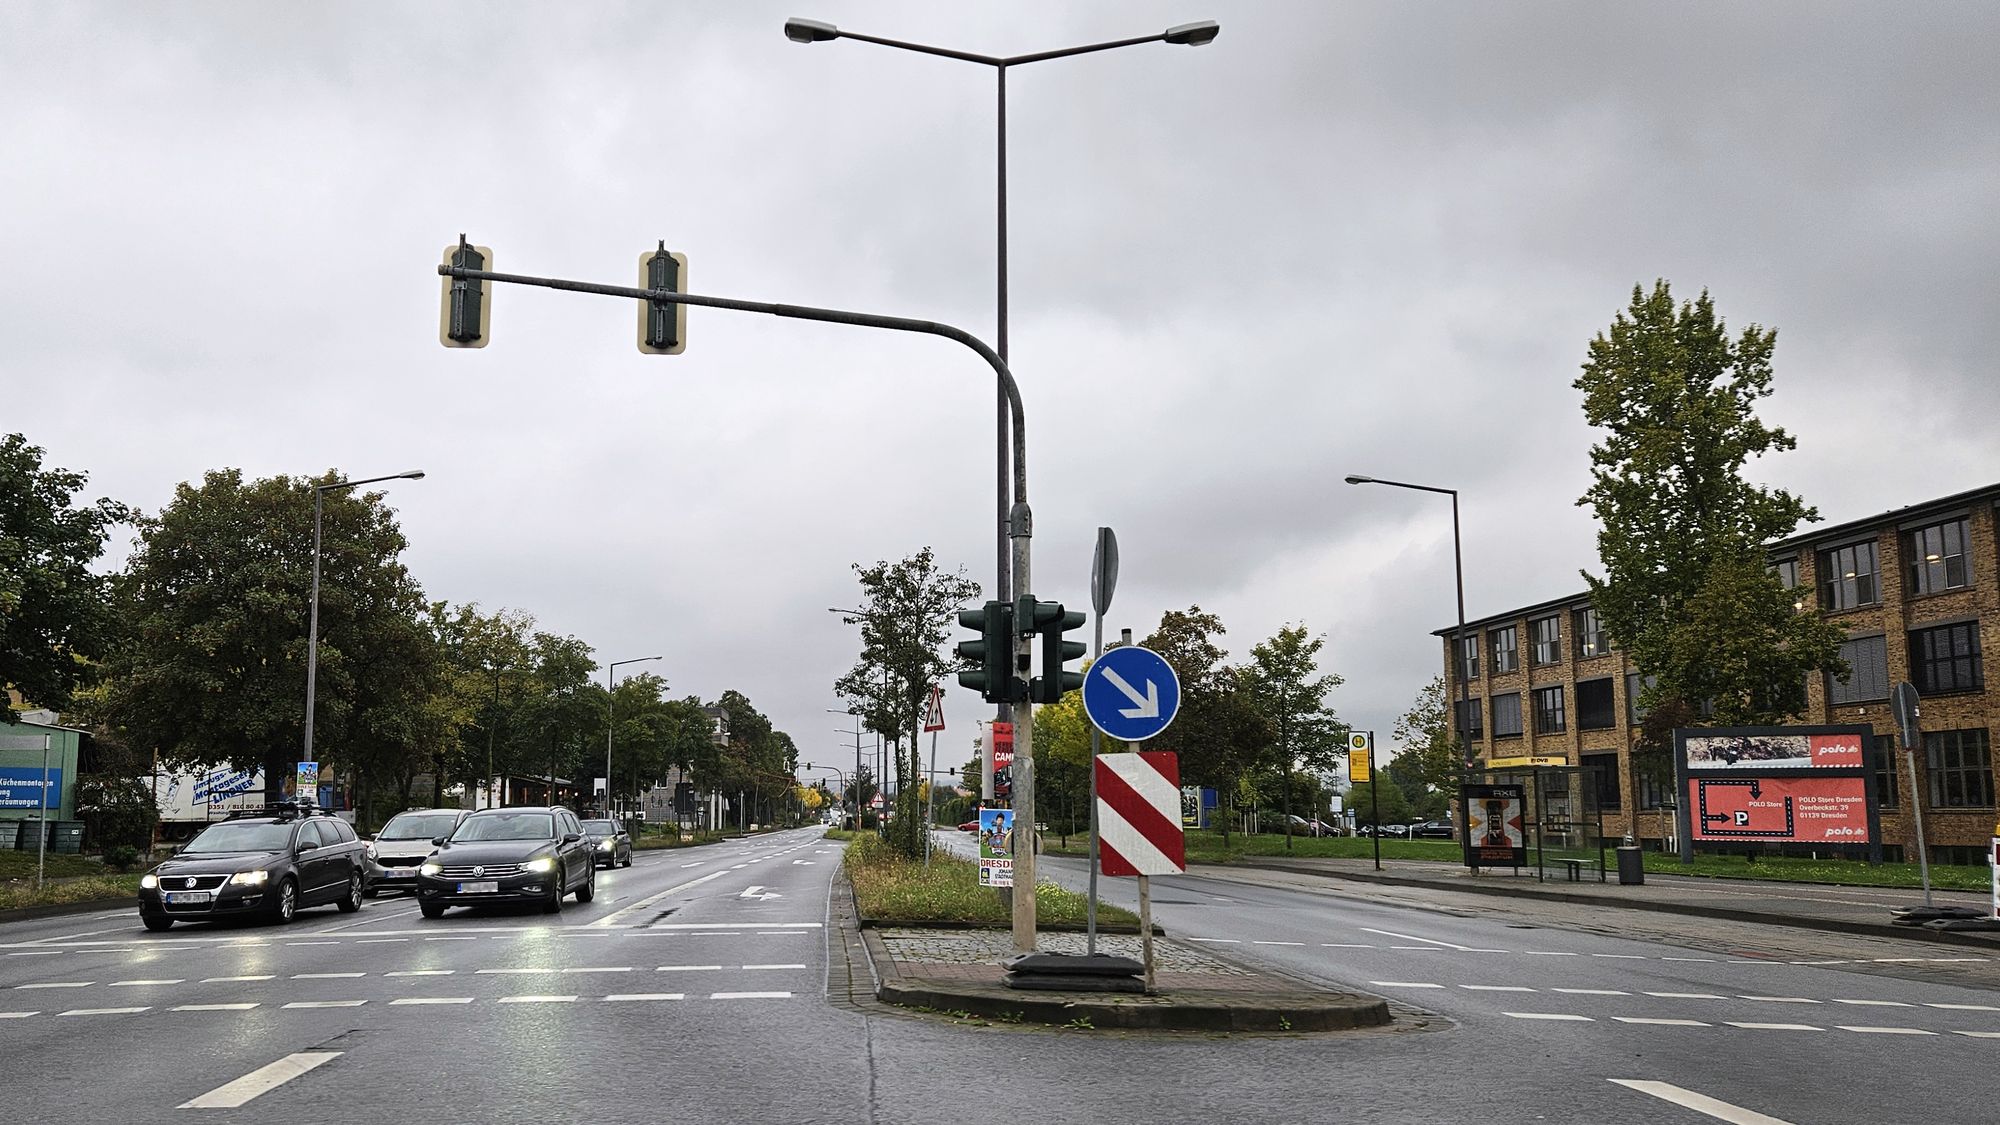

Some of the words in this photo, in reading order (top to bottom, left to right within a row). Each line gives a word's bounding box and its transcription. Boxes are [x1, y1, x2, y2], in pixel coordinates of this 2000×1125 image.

[1819, 744, 1846, 755] polo
[213, 779, 255, 804] LINDNER
[1493, 789, 1517, 797] AXE
[1735, 811, 1748, 825] P
[1825, 826, 1853, 838] polo
